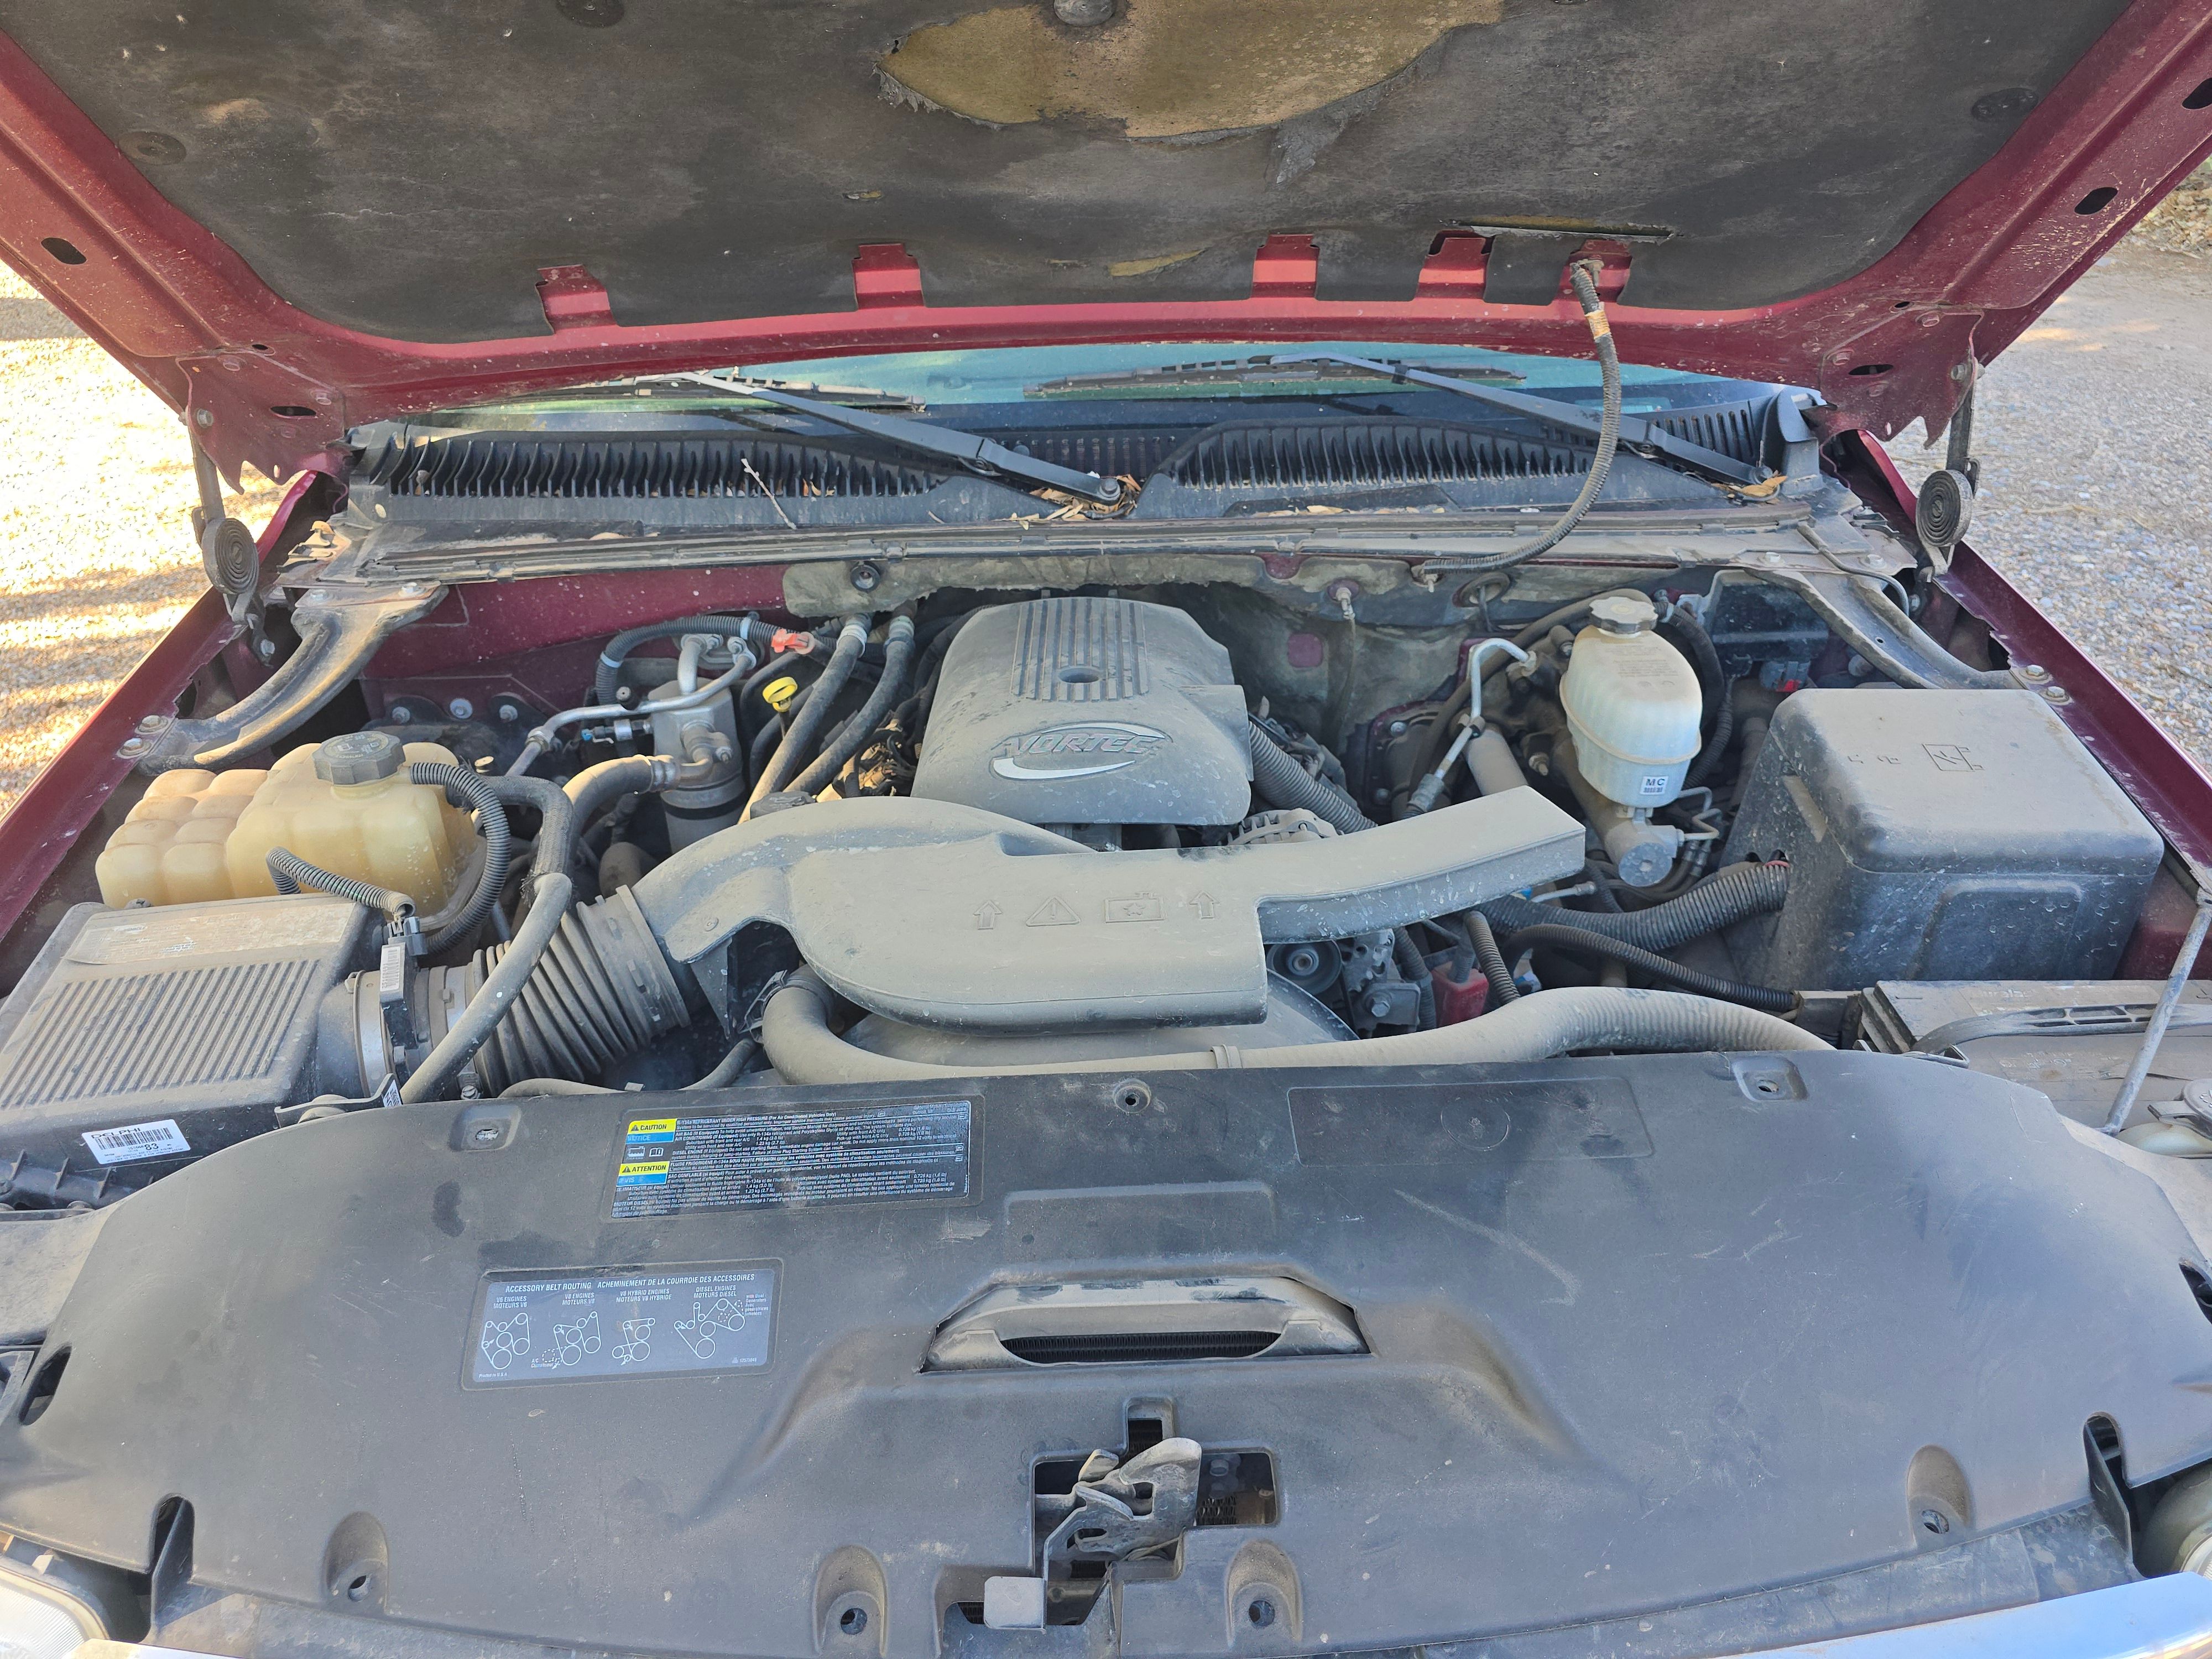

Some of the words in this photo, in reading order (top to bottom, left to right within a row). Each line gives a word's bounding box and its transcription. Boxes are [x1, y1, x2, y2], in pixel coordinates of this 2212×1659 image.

[1005, 732, 1158, 755] VORTEC
[91, 1128, 140, 1139] DELPHI
[597, 1279, 646, 1288] ACHEMINEMENT
[713, 1274, 754, 1282] ACCESSOIRES
[505, 1284, 544, 1292] ACCESSORY
